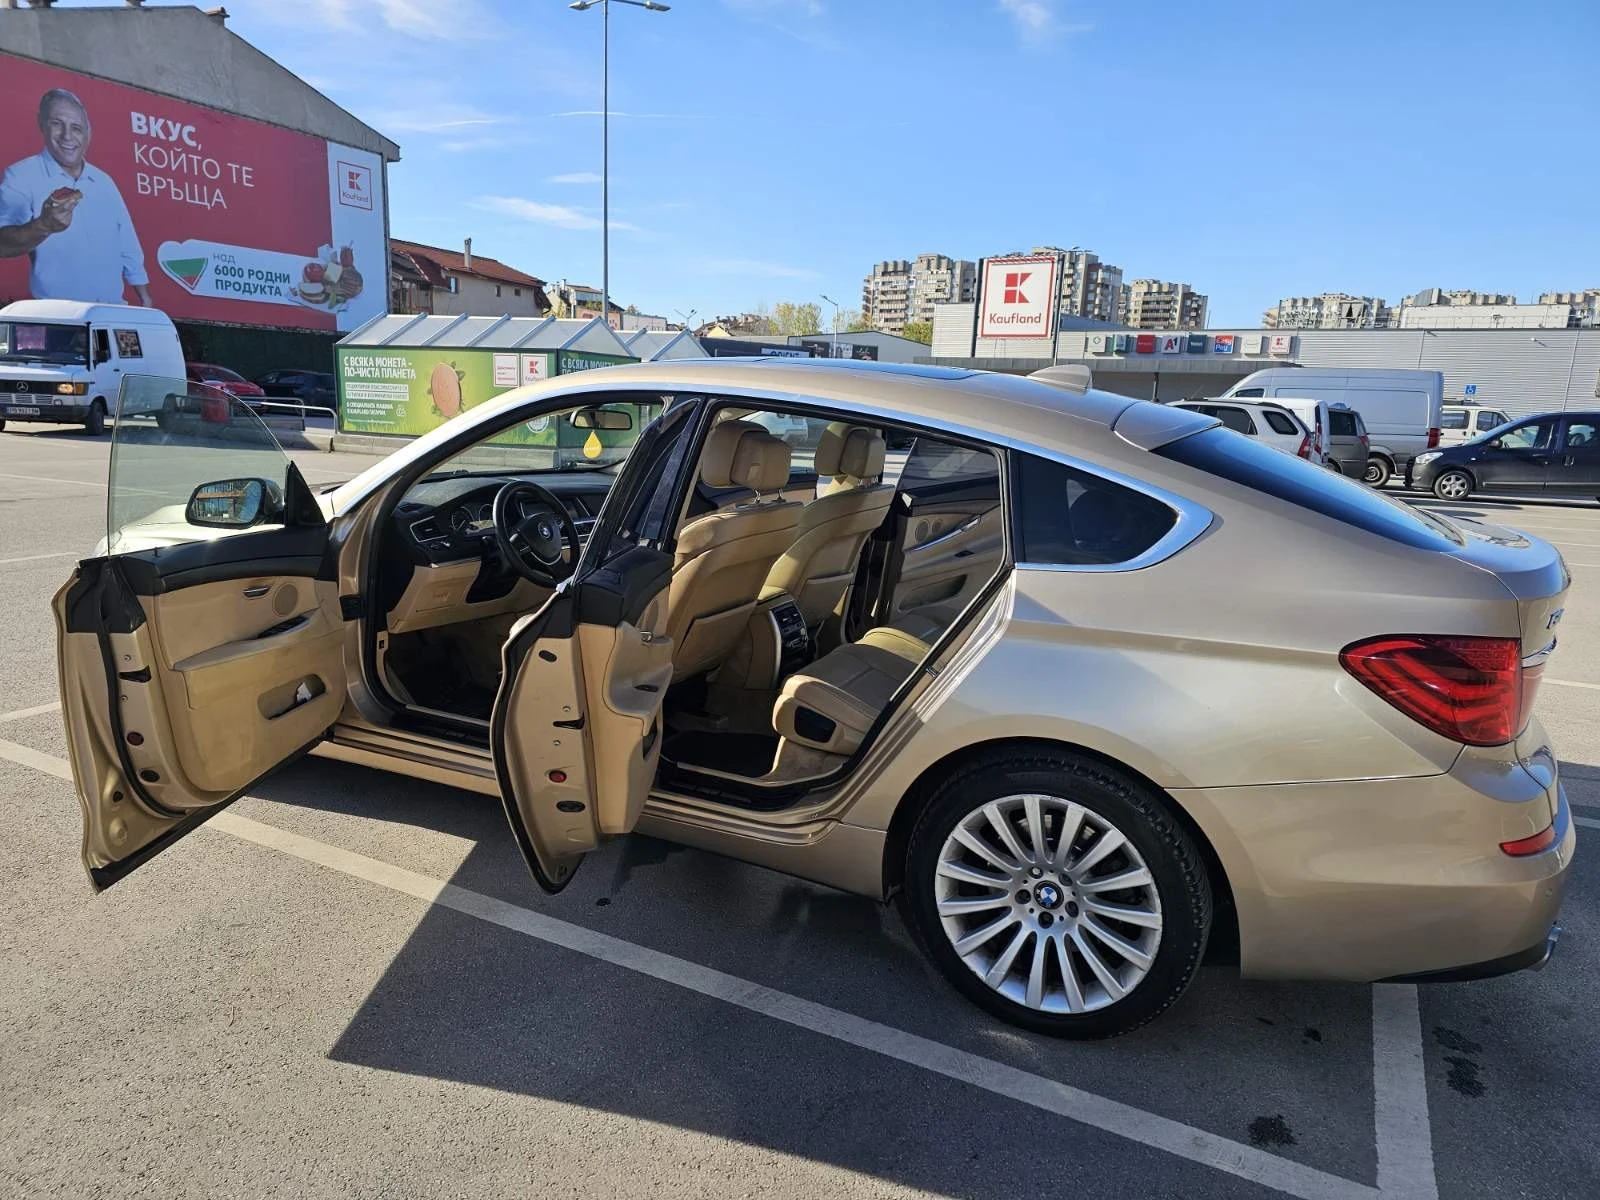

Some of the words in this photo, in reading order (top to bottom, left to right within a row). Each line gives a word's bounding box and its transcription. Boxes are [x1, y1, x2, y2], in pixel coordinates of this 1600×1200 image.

[130, 111, 202, 151] ВКУС,
[134, 141, 221, 180] КОЙТО
[227, 162, 255, 187] ТЕ
[136, 172, 228, 210] ВРЪЩА
[214, 265, 244, 279] 6000
[247, 268, 291, 284] РОДНИ
[215, 279, 282, 297] ПРОДУКТА
[989, 312, 1042, 324] Kaufland
[344, 356, 349, 366] С
[350, 356, 374, 367] ВСЯКА
[375, 357, 406, 368] МОНЕТА
[344, 367, 380, 378] ПО-ЧИСТА
[381, 368, 416, 379] ПЛАНЕТА
